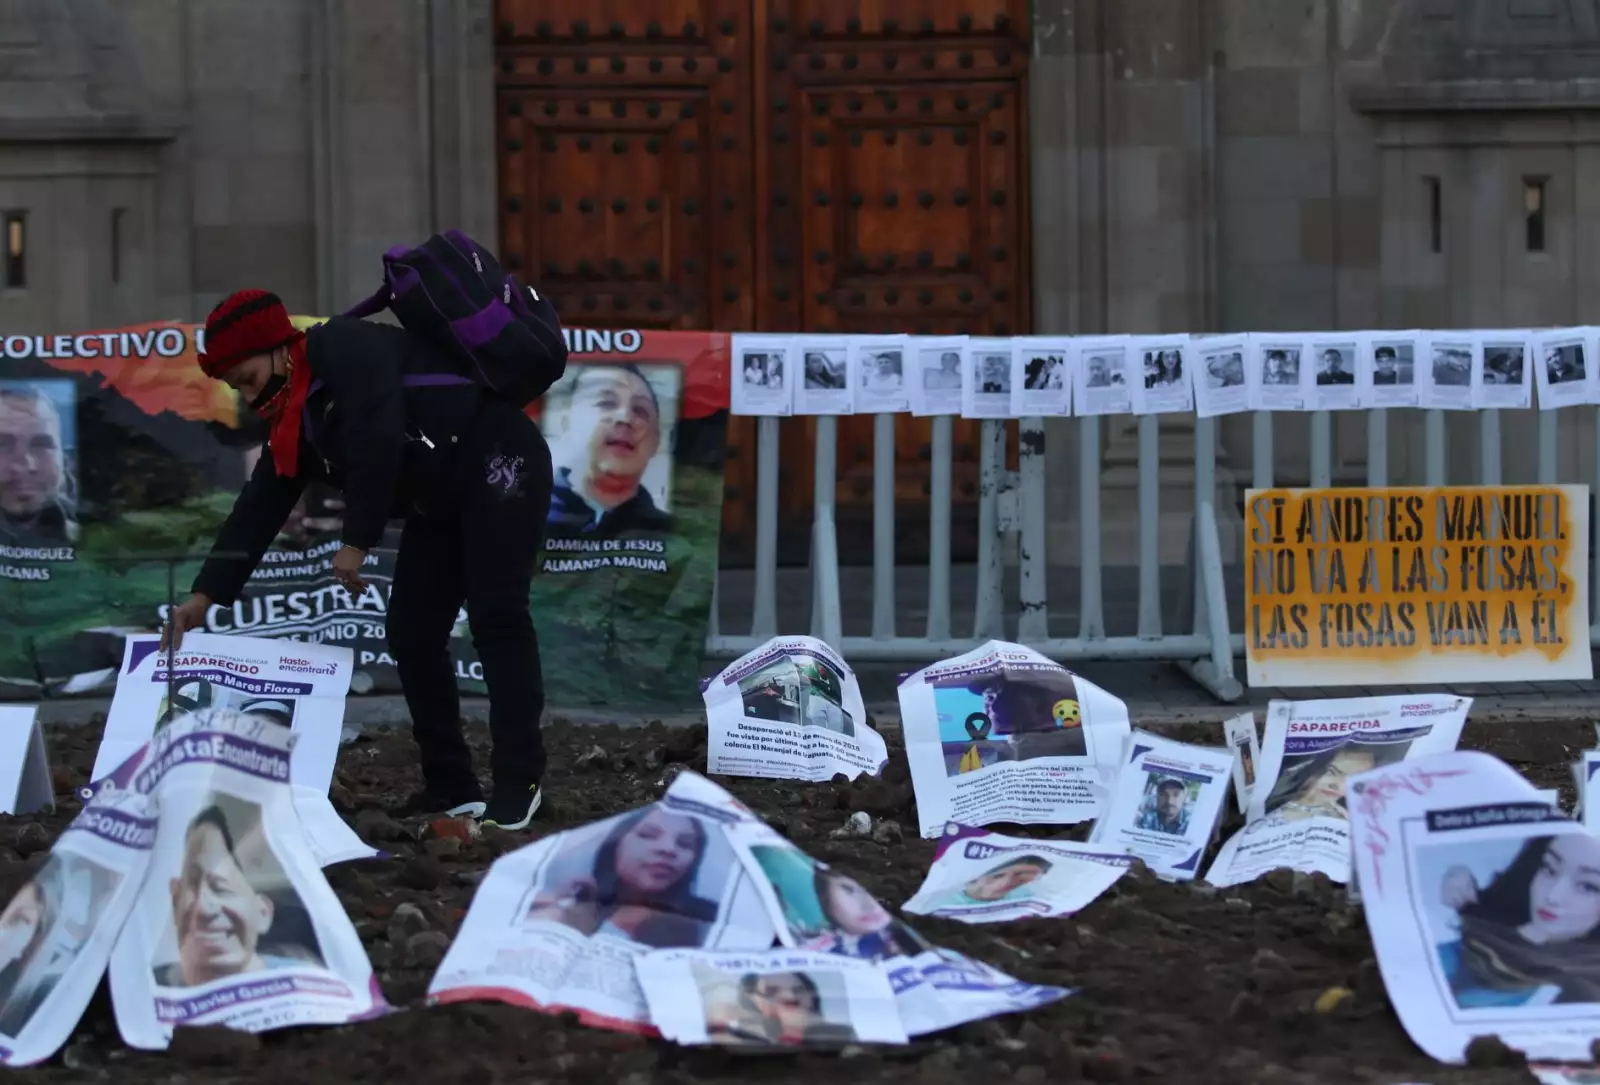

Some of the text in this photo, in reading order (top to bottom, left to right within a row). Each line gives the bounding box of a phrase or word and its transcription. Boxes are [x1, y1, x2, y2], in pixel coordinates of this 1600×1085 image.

[0, 328, 185, 358] OLECTIVO
[1252, 494, 1566, 544] SI ANDRES MANUEL
[545, 539, 664, 552] DAMIAN DE JESUS
[262, 551, 304, 562] KEVIN
[613, 556, 667, 572] MAUNA
[1252, 544, 1568, 595] NO VA A LAS FOSAS,
[1252, 603, 1309, 650] LAS
[1319, 601, 1417, 650] FOSAS
[1426, 600, 1490, 647] VAN
[1499, 600, 1523, 646] A
[224, 675, 262, 692] Mares
[264, 682, 301, 694] Flores
[1288, 719, 1381, 733] SAPARECIDA
[727, 731, 740, 739] fue
[724, 741, 752, 750] colonia
[753, 743, 760, 751] El
